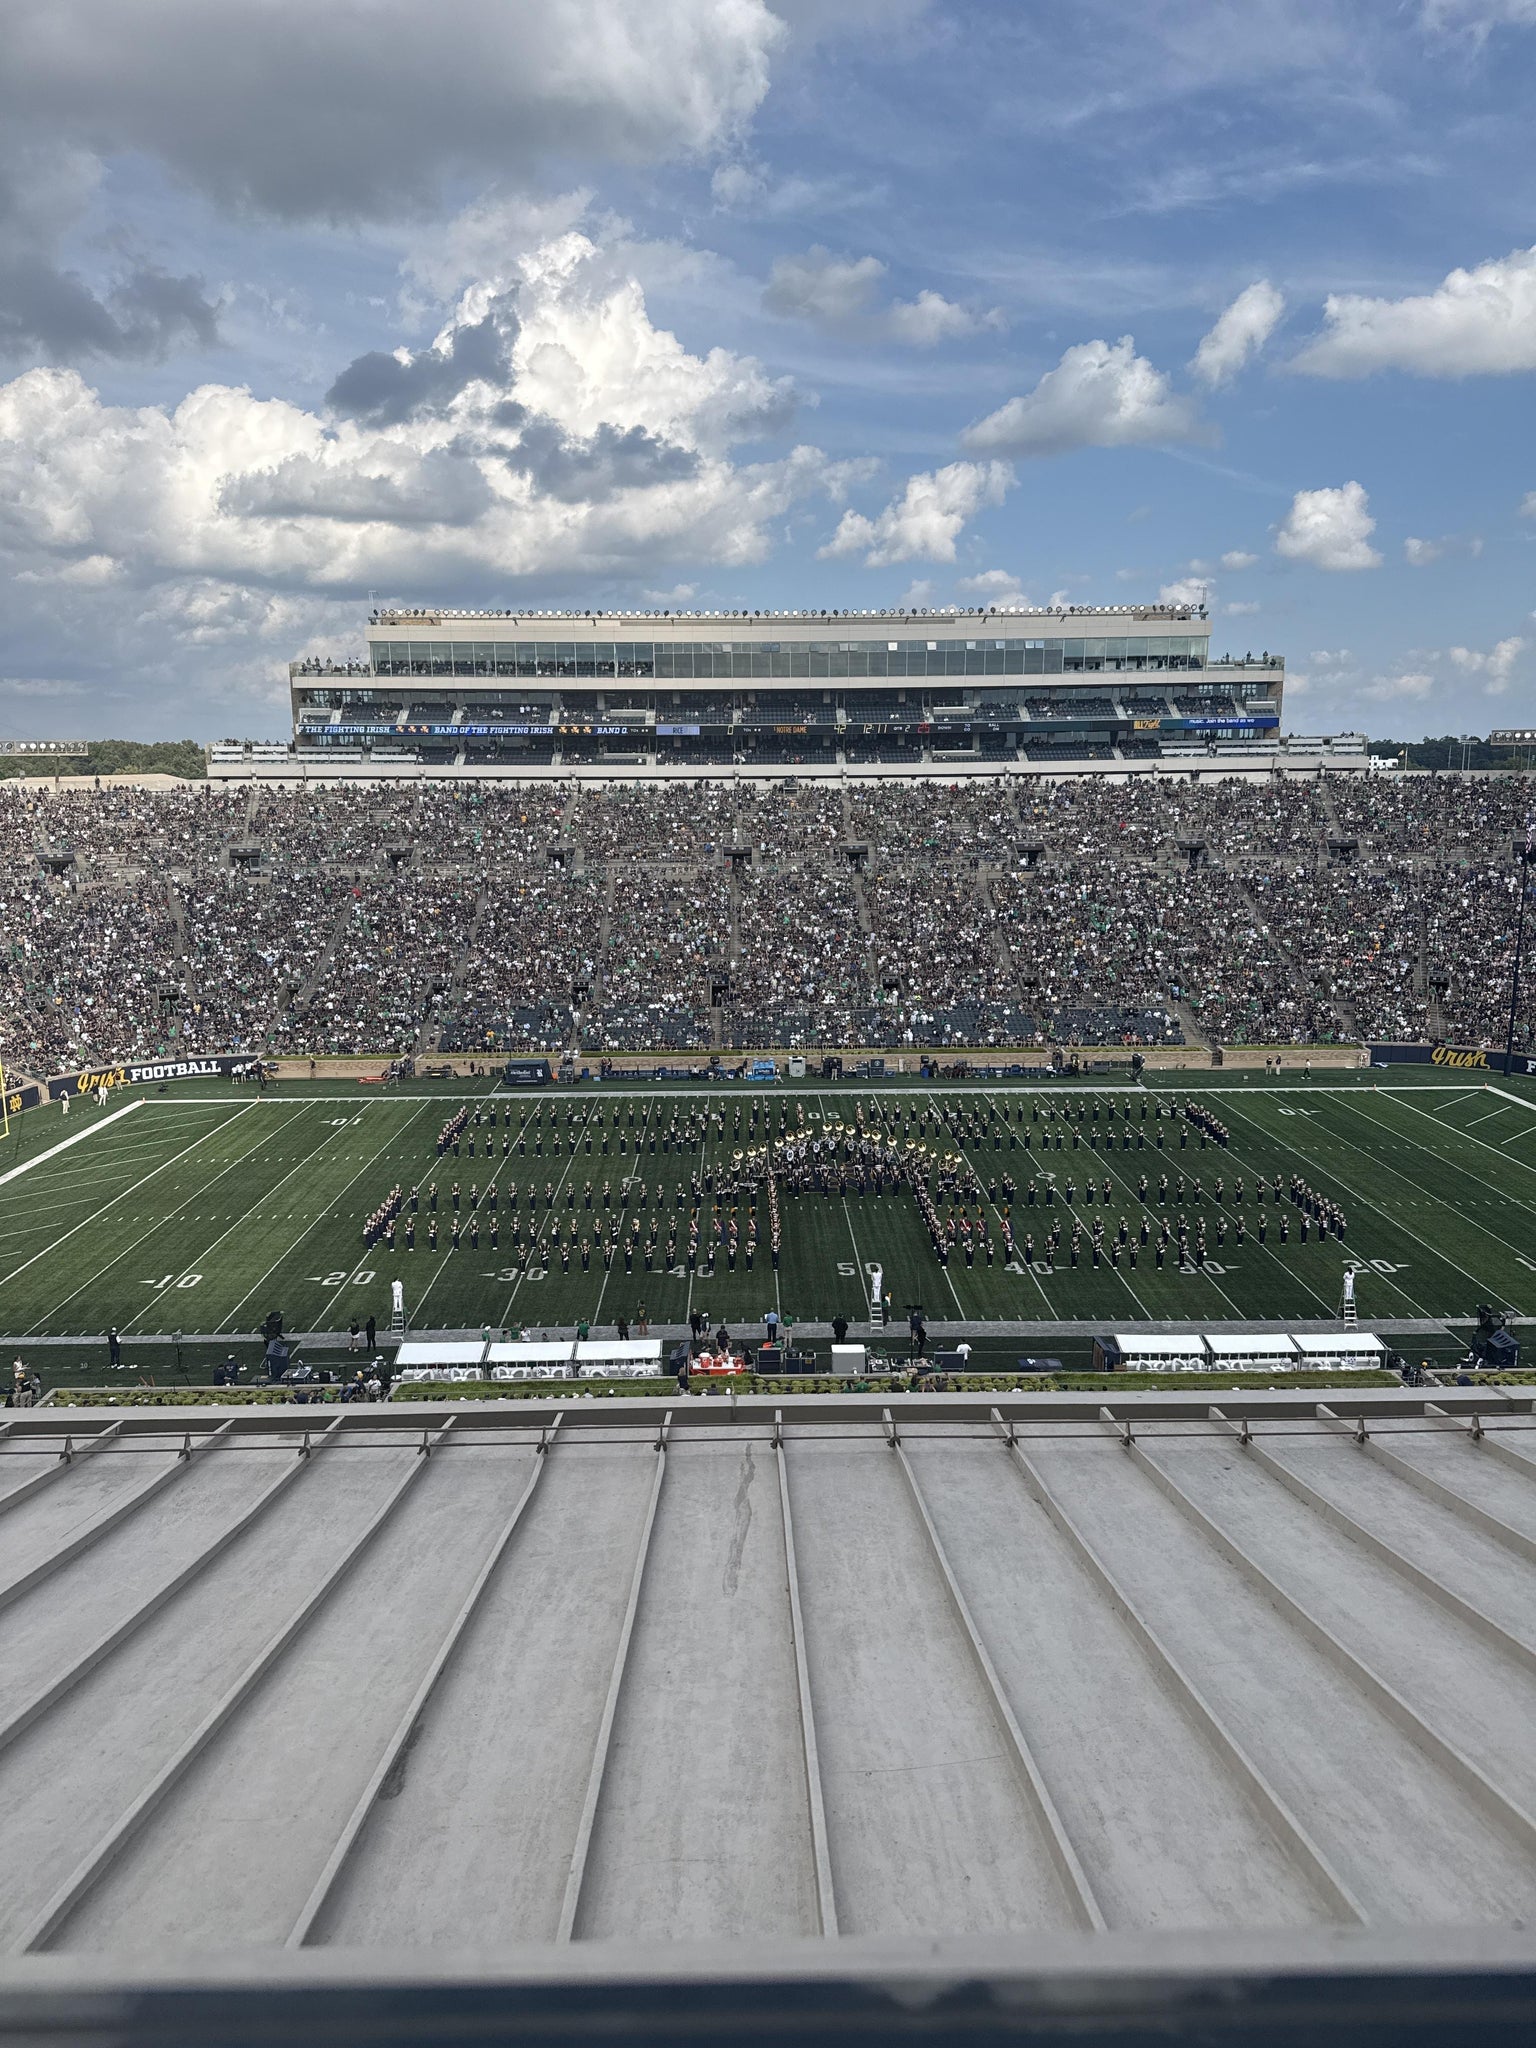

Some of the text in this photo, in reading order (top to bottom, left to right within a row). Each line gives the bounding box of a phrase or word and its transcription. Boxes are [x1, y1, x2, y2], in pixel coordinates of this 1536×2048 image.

[672, 727, 684, 735] RICE
[776, 726, 791, 734] NOTRE
[792, 726, 807, 734] DAME
[833, 724, 846, 735] 42
[863, 724, 887, 734] 12:11
[904, 724, 911, 733] 2
[1431, 1047, 1490, 1070] Irish
[130, 1061, 221, 1082] FOOTBALL
[1525, 1060, 1536, 1073] F
[667, 1265, 714, 1278] 40
[836, 1262, 883, 1276] 50
[1004, 1261, 1054, 1275] 40
[1172, 1261, 1227, 1274] 30
[1341, 1260, 1397, 1273] 20
[321, 1271, 376, 1286] 20
[497, 1267, 545, 1281] 30
[153, 1274, 204, 1289] 10
